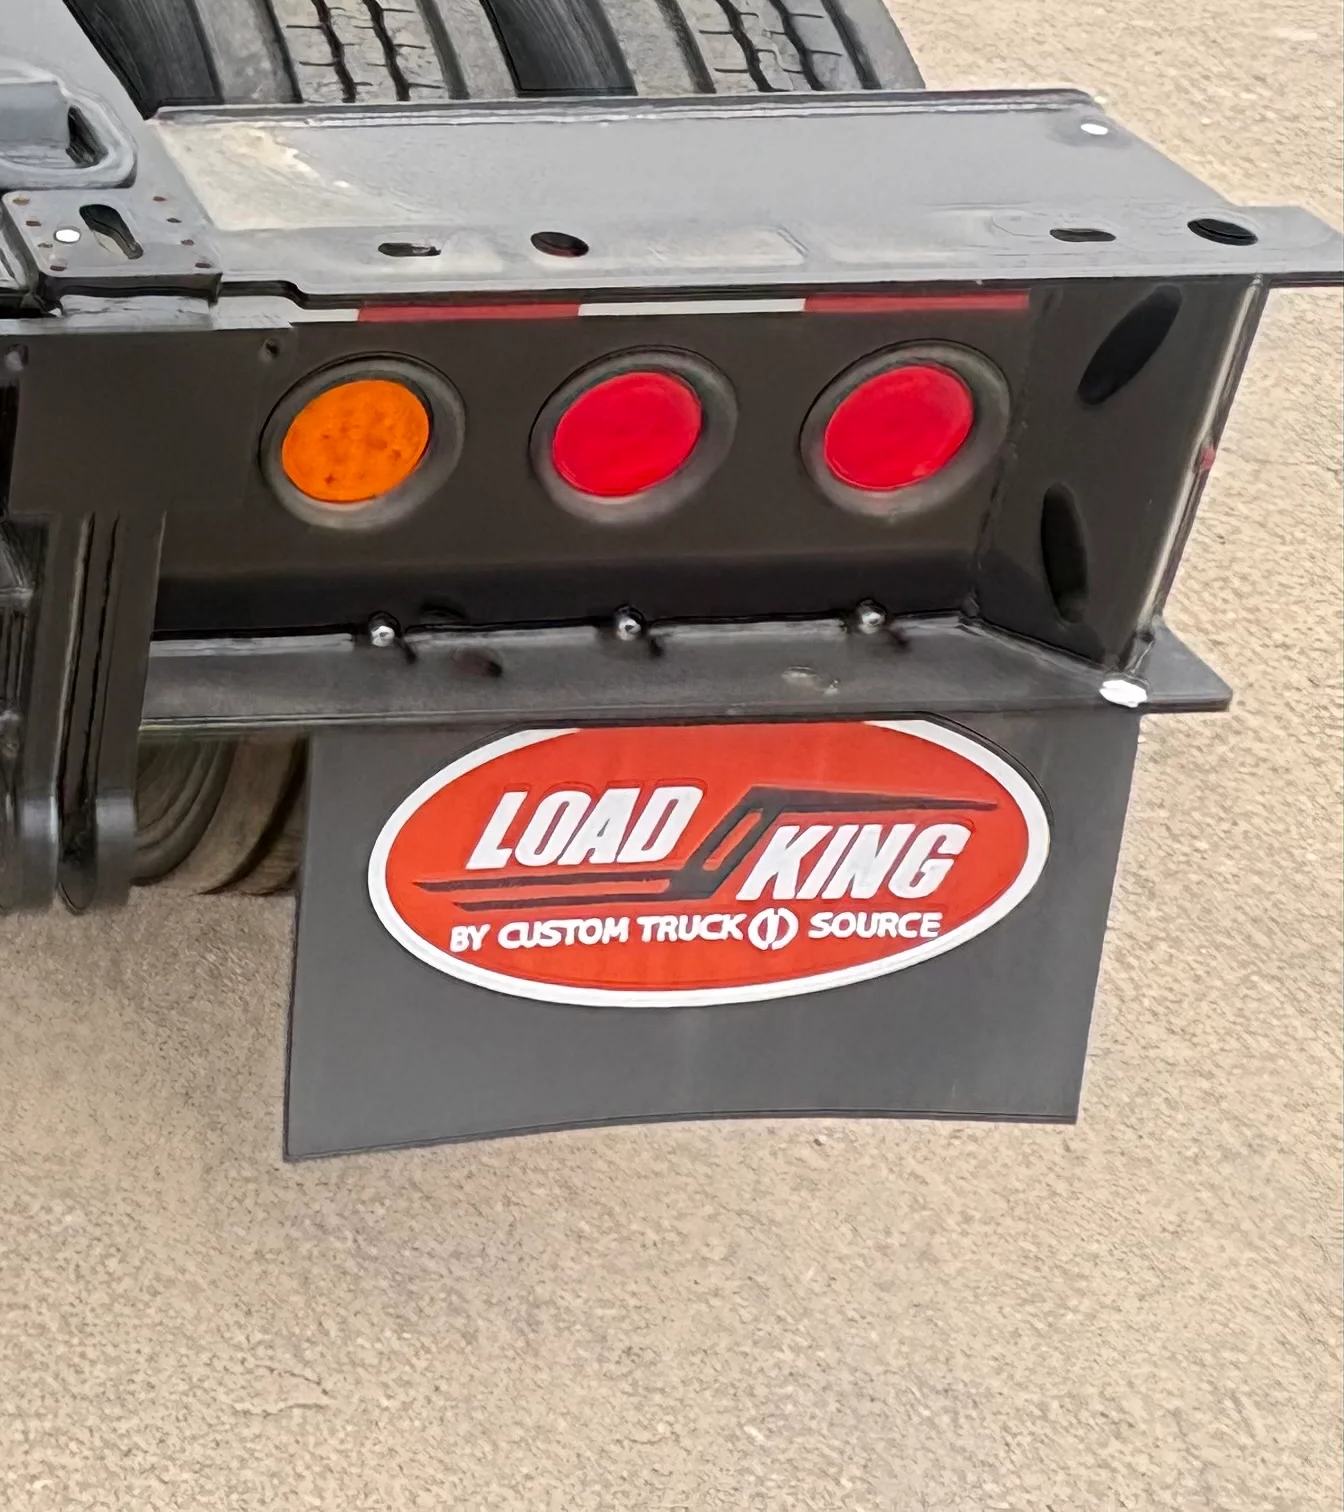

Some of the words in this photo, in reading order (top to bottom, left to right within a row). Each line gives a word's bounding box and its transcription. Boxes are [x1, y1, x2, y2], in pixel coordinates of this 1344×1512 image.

[466, 786, 703, 871] LOAD
[736, 822, 974, 901] KING
[449, 923, 491, 952] BY
[498, 917, 629, 949] CUSTOM
[637, 912, 747, 942] TRUCK
[808, 912, 943, 940] SOURCE
